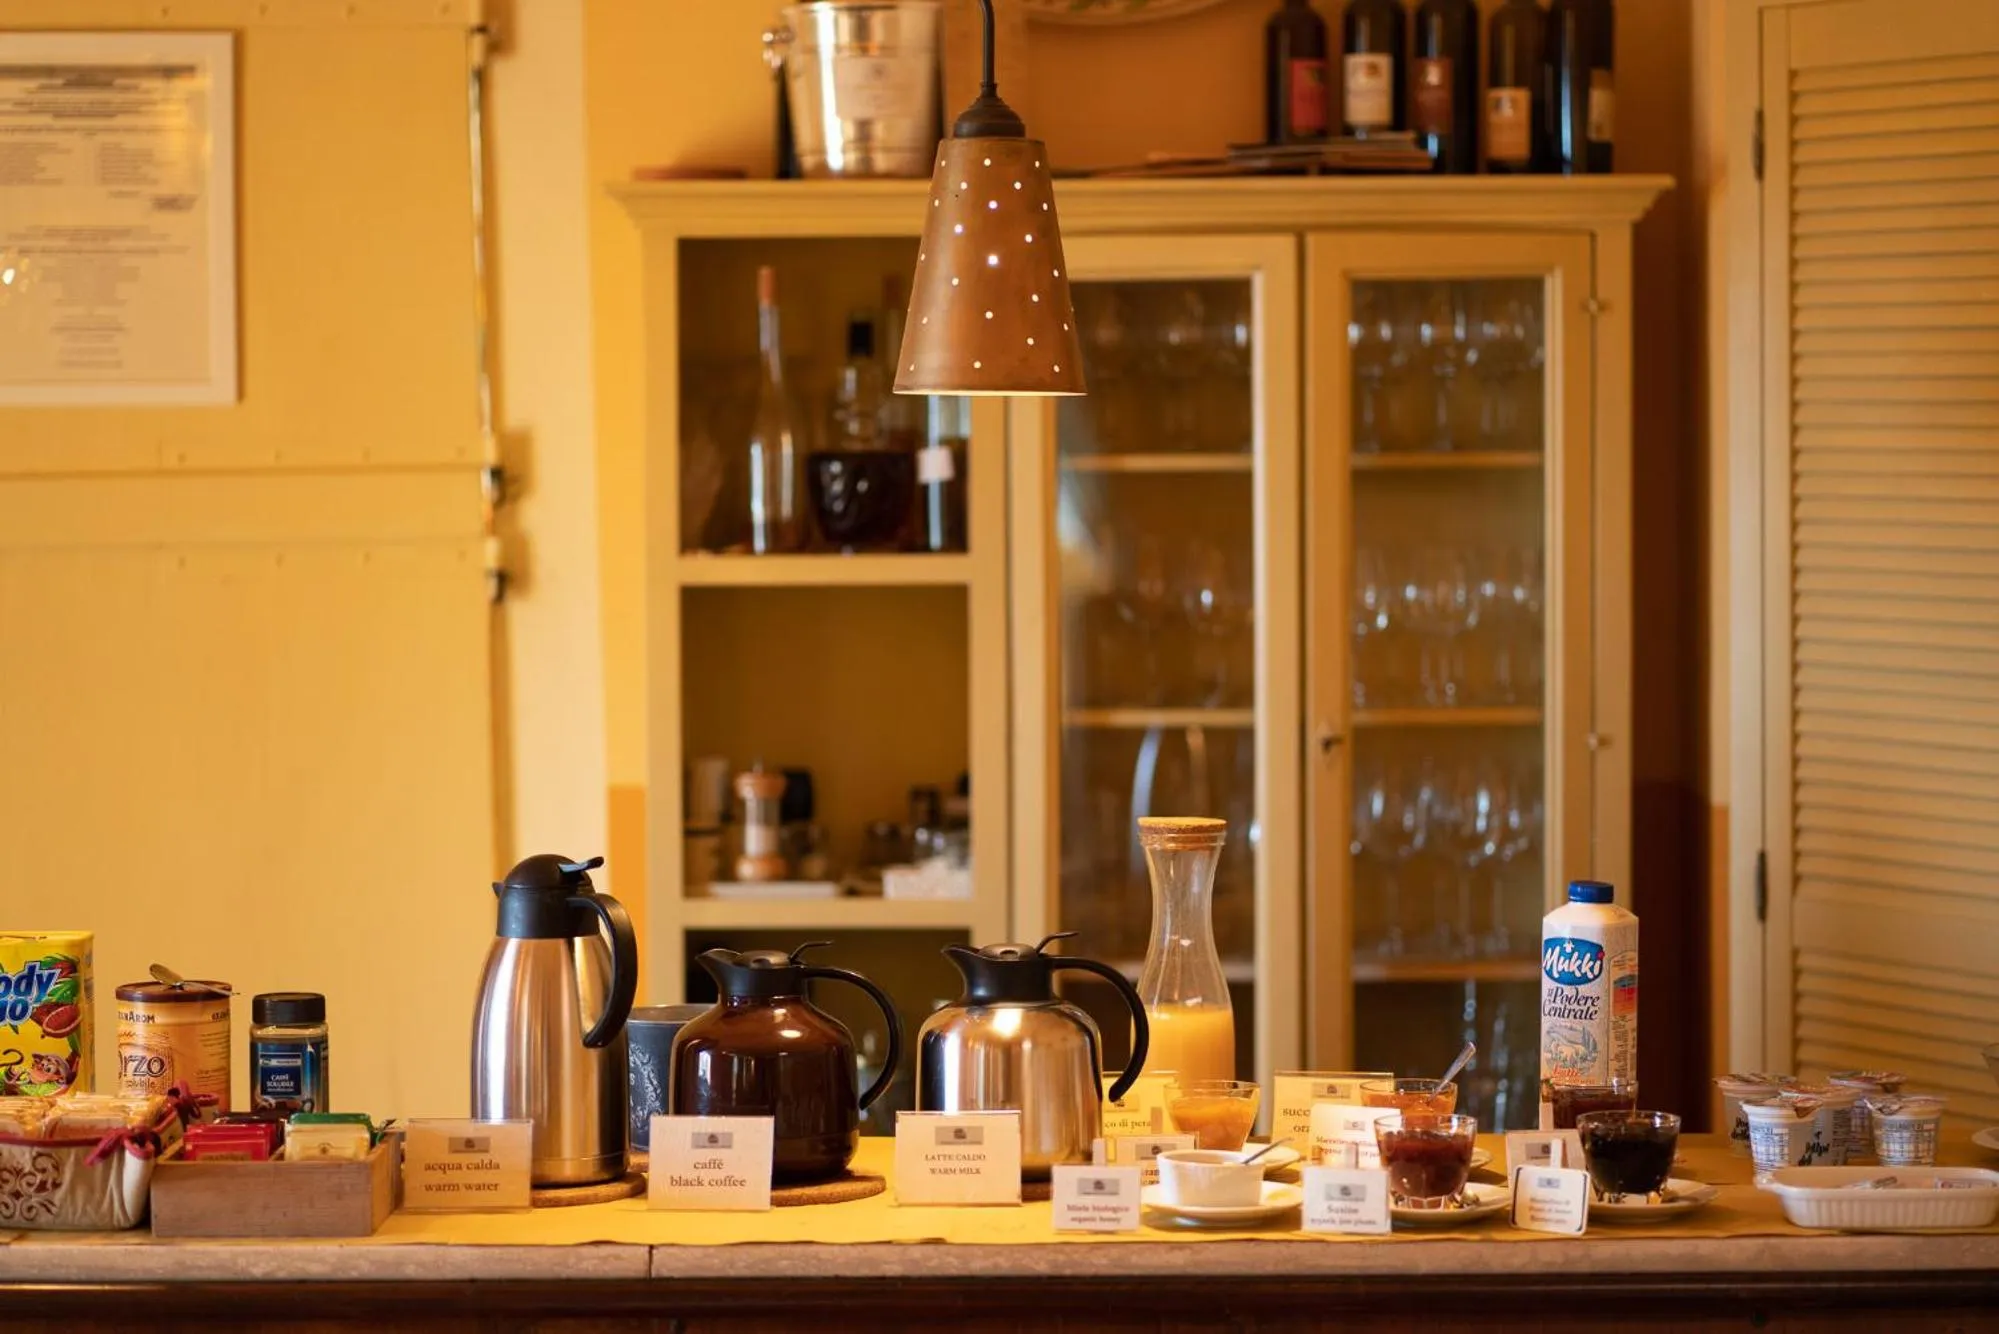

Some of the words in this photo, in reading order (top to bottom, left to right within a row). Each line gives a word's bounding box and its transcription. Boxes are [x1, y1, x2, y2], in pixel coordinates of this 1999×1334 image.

[1542, 946, 1605, 979] Mukki
[1553, 986, 1600, 1007] Podere
[1543, 998, 1600, 1020] Centrale
[118, 1049, 166, 1079] rzo
[424, 1162, 463, 1174] acqua
[466, 1159, 500, 1171] calda
[424, 1183, 460, 1192] warm
[463, 1182, 499, 1192] water
[670, 1175, 704, 1187] black
[707, 1175, 746, 1187] coffee
